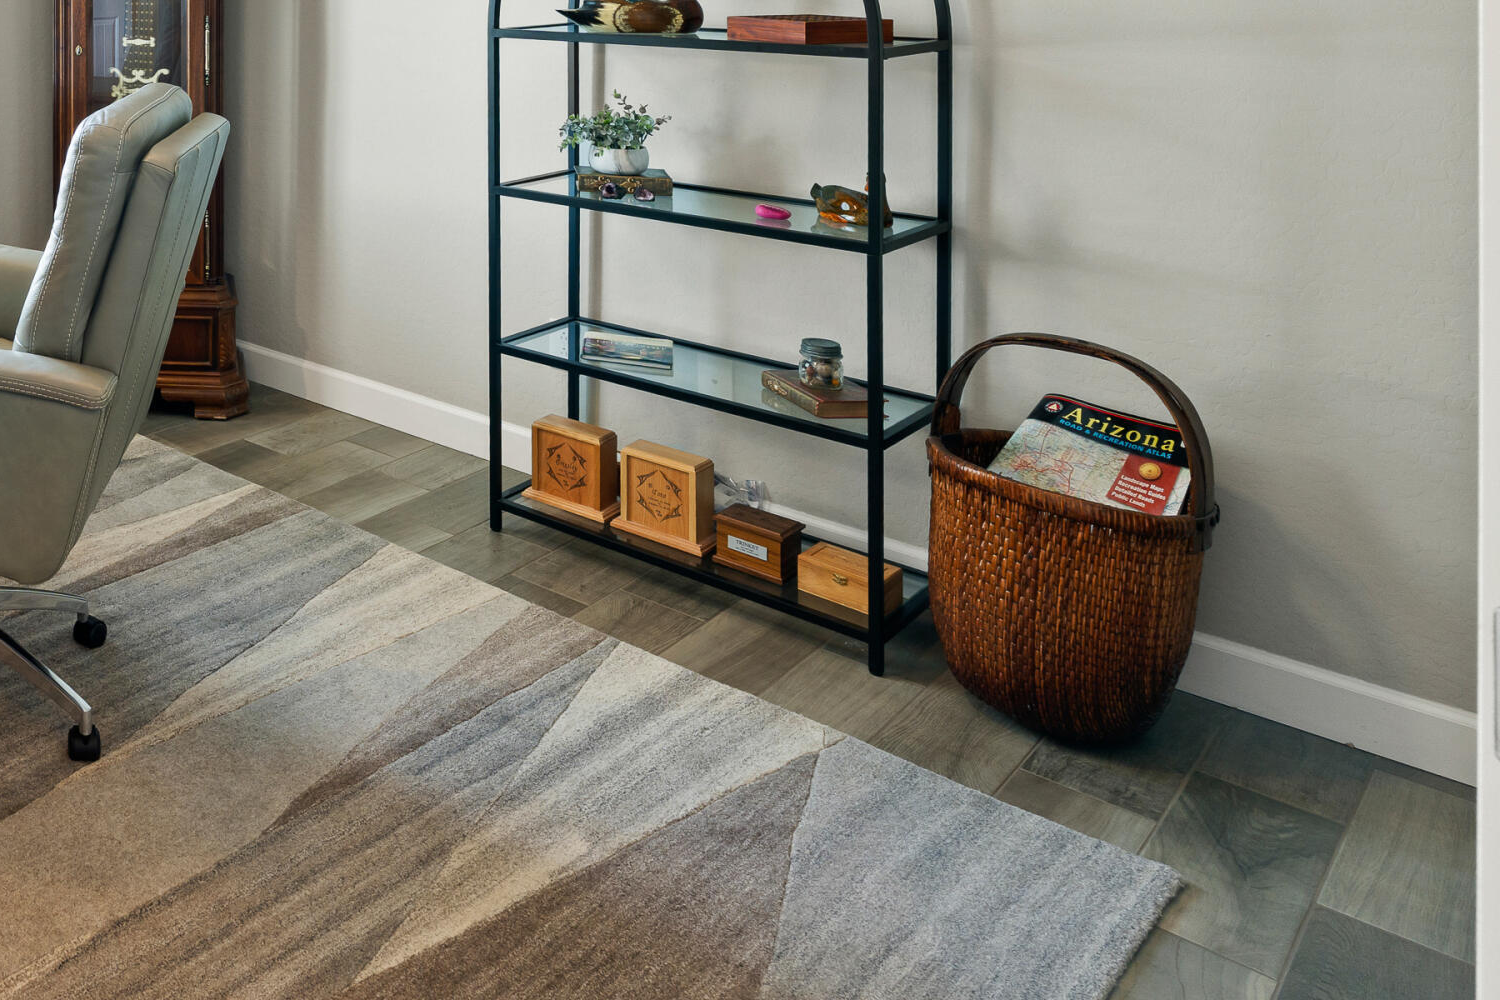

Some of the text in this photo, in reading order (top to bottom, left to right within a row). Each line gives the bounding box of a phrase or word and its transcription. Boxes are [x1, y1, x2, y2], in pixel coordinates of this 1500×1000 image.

[1059, 418, 1083, 431] ROAD
[1092, 431, 1146, 452] RECREATION
[1146, 448, 1173, 460] ATLAS
[1062, 407, 1175, 452] Arizona
